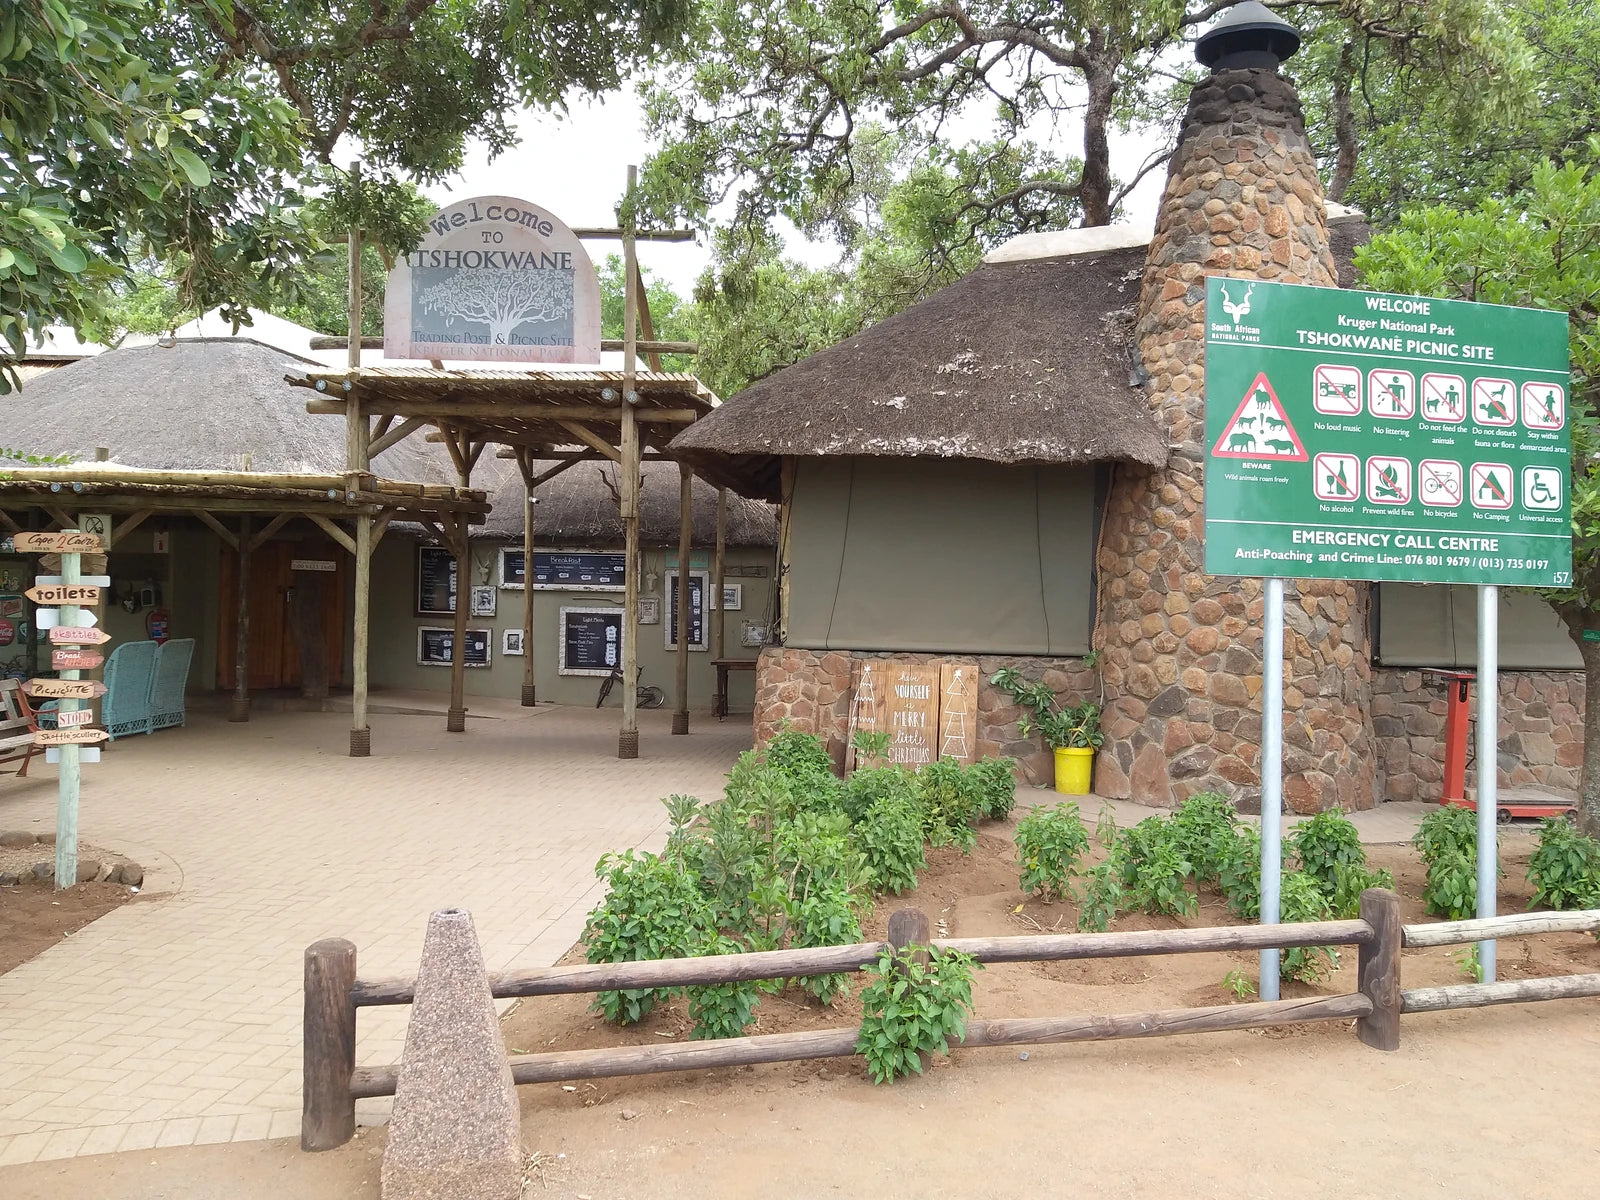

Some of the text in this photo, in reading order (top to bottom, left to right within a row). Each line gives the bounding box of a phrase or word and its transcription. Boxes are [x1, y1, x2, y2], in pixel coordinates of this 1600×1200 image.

[430, 202, 553, 238] Welcome
[482, 232, 504, 244] TO
[416, 250, 572, 270] TSHOKWANE
[1365, 297, 1430, 316] WELCOME
[1212, 322, 1260, 334] South African
[1338, 314, 1455, 336] Kruger National Park
[496, 333, 505, 344] &
[1212, 332, 1260, 342] NATIONAL PARKS
[1296, 330, 1494, 360] TSHOKWANE PICNIC SITE
[1314, 422, 1325, 430] No
[1327, 422, 1341, 431] loud
[1386, 427, 1410, 437] littering
[1442, 424, 1456, 432] feed
[1457, 425, 1468, 433] the
[1472, 427, 1517, 437] Do not disturb
[1432, 437, 1455, 445] animals
[1528, 431, 1559, 440] Stay within
[1501, 440, 1515, 449] flora
[1520, 443, 1553, 452] demarcated
[1274, 476, 1289, 484] freely
[1331, 505, 1354, 513] alcohol
[1435, 510, 1458, 518] bicycles
[1484, 513, 1510, 522] Camping
[1519, 514, 1544, 522] Universal
[28, 534, 54, 546] Cape
[56, 536, 66, 548] 2
[1292, 530, 1498, 552] EMERGENCY CALL CENTRE
[1235, 548, 1549, 570] Anti-Poaching and Crime Line: 076 801 9679 / (013) 735 0197
[1554, 572, 1569, 584] i57
[36, 588, 97, 600] toilets
[894, 685, 930, 699] YOURSELF
[894, 712, 925, 728] MERRY
[892, 730, 926, 745] little
[888, 748, 930, 763] CHRISTMAS
